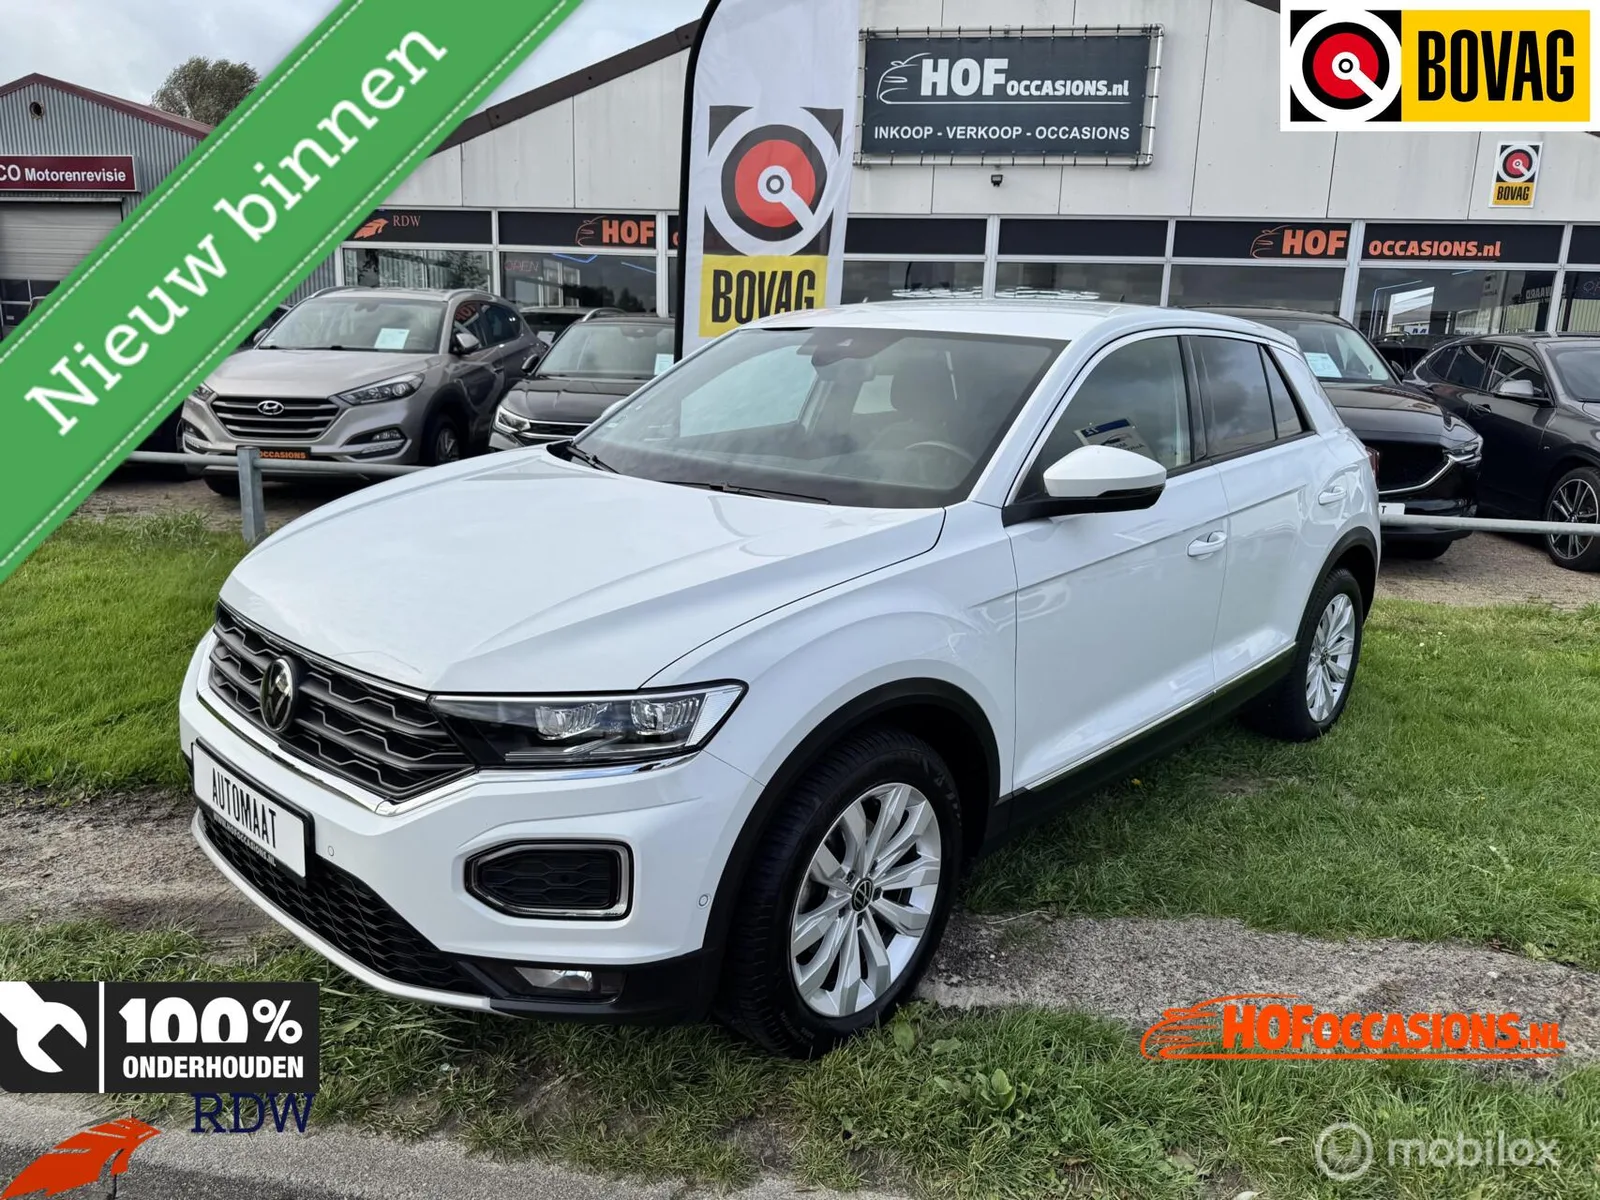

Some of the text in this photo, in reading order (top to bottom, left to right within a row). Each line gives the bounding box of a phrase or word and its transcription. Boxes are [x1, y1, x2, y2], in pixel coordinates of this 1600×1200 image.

[874, 126, 933, 139] INKOOP
[946, 126, 1022, 139] VERKOOP
[1035, 126, 1130, 140] OCCASIONS
[24, 167, 126, 182] Motorenrevisie
[1496, 186, 1530, 201] BOVAG
[393, 215, 421, 227] RDW
[602, 220, 655, 244] HOF
[1281, 229, 1501, 257] HOF OCCASIONS.nl
[711, 269, 816, 324] BOVAG
[212, 767, 277, 849] AUTOMAAT
